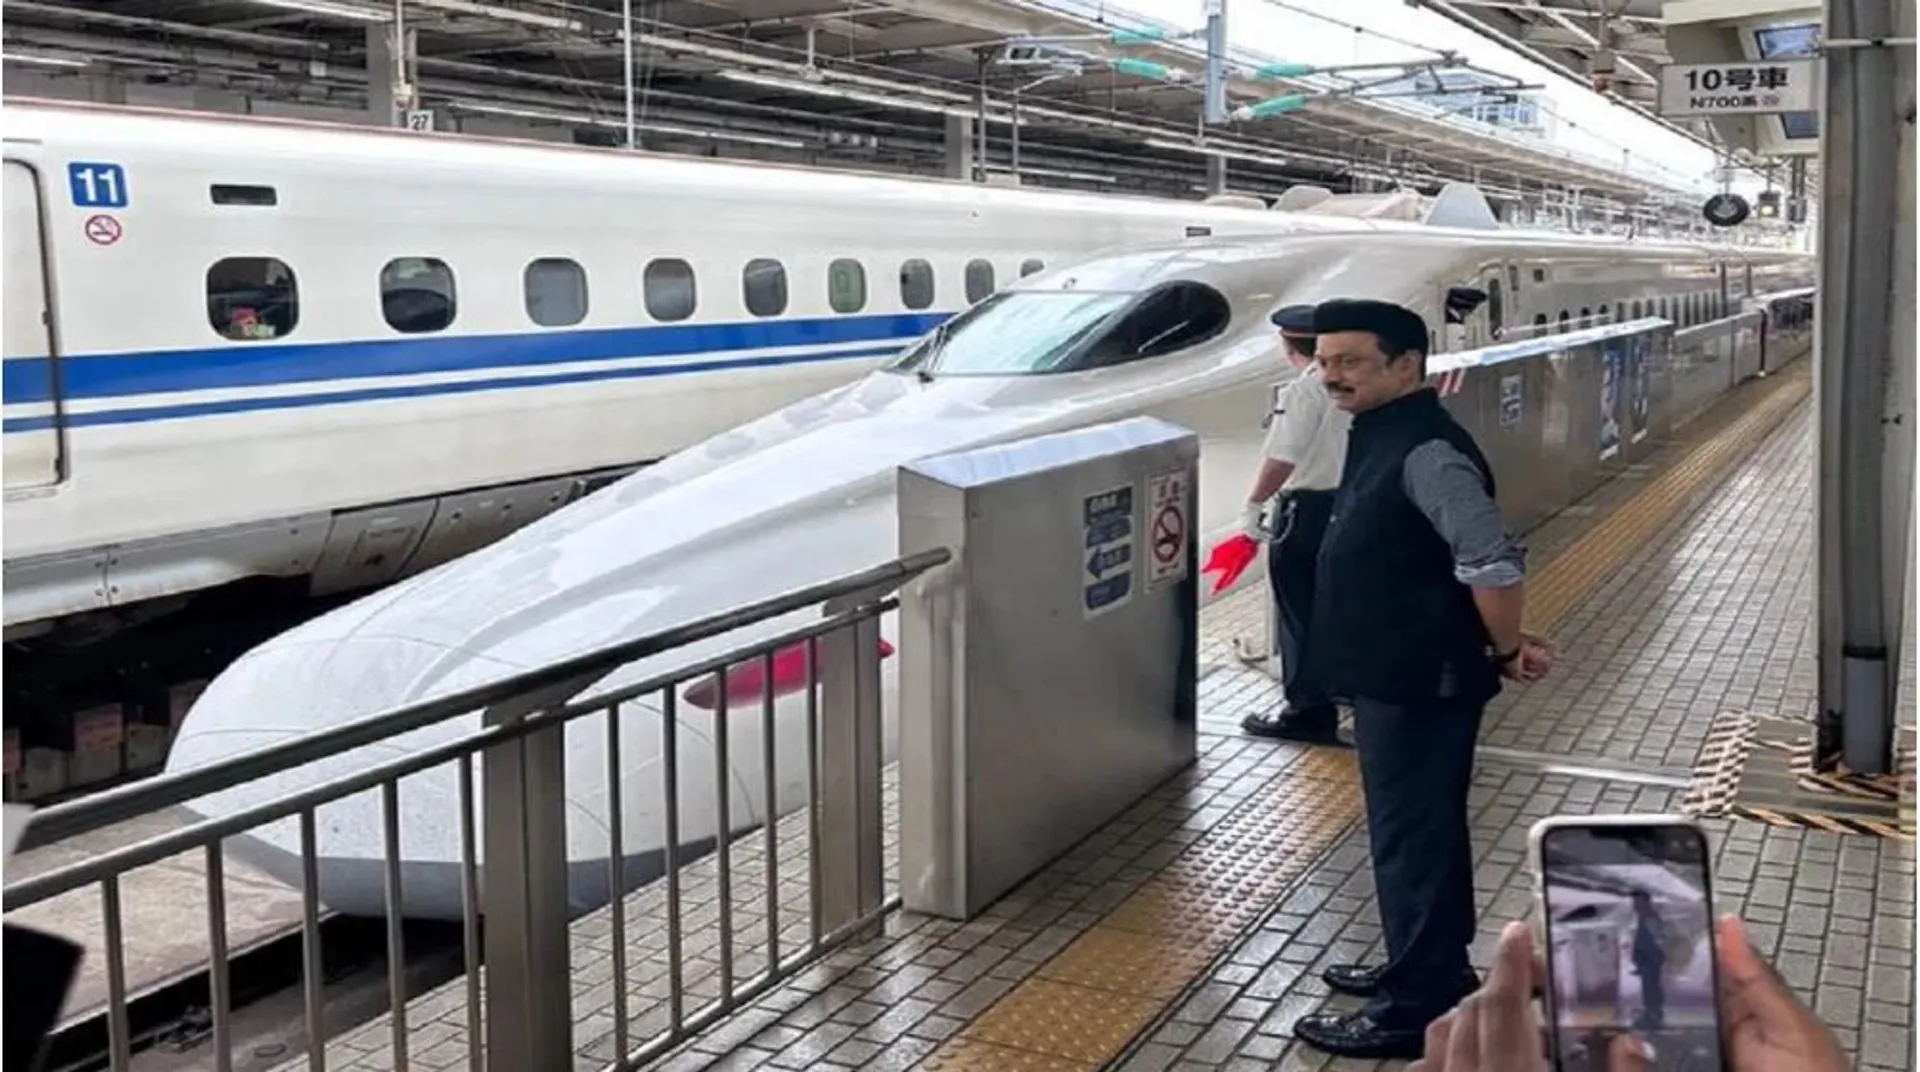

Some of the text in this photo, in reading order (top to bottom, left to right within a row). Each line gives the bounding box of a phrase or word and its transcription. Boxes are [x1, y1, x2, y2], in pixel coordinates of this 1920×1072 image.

[1685, 67, 1788, 91] 10号車
[411, 114, 428, 131] 27
[76, 168, 118, 203] 11
